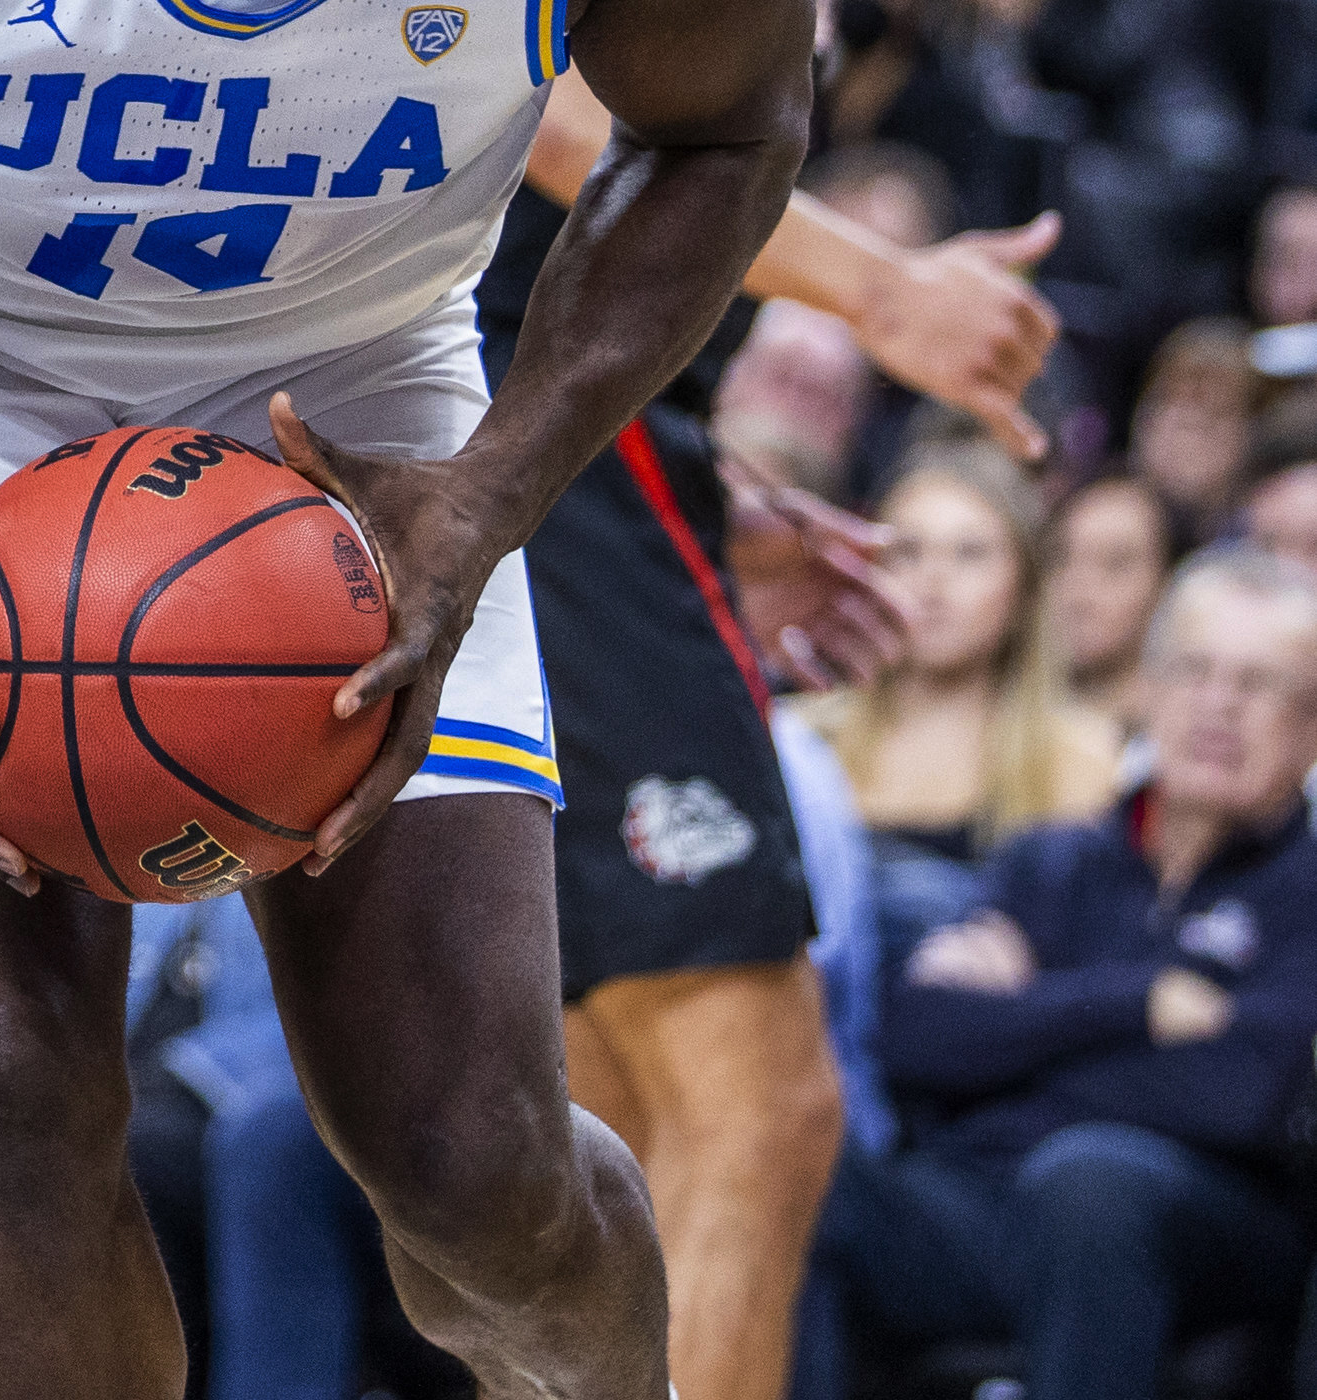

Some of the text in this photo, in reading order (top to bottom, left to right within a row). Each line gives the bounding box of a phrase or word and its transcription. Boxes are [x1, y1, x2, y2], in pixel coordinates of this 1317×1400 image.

[407, 9, 465, 43] PAC
[414, 32, 447, 52] 12
[26, 203, 292, 300] 14
[127, 433, 283, 500] son
[139, 819, 280, 899] Wi
